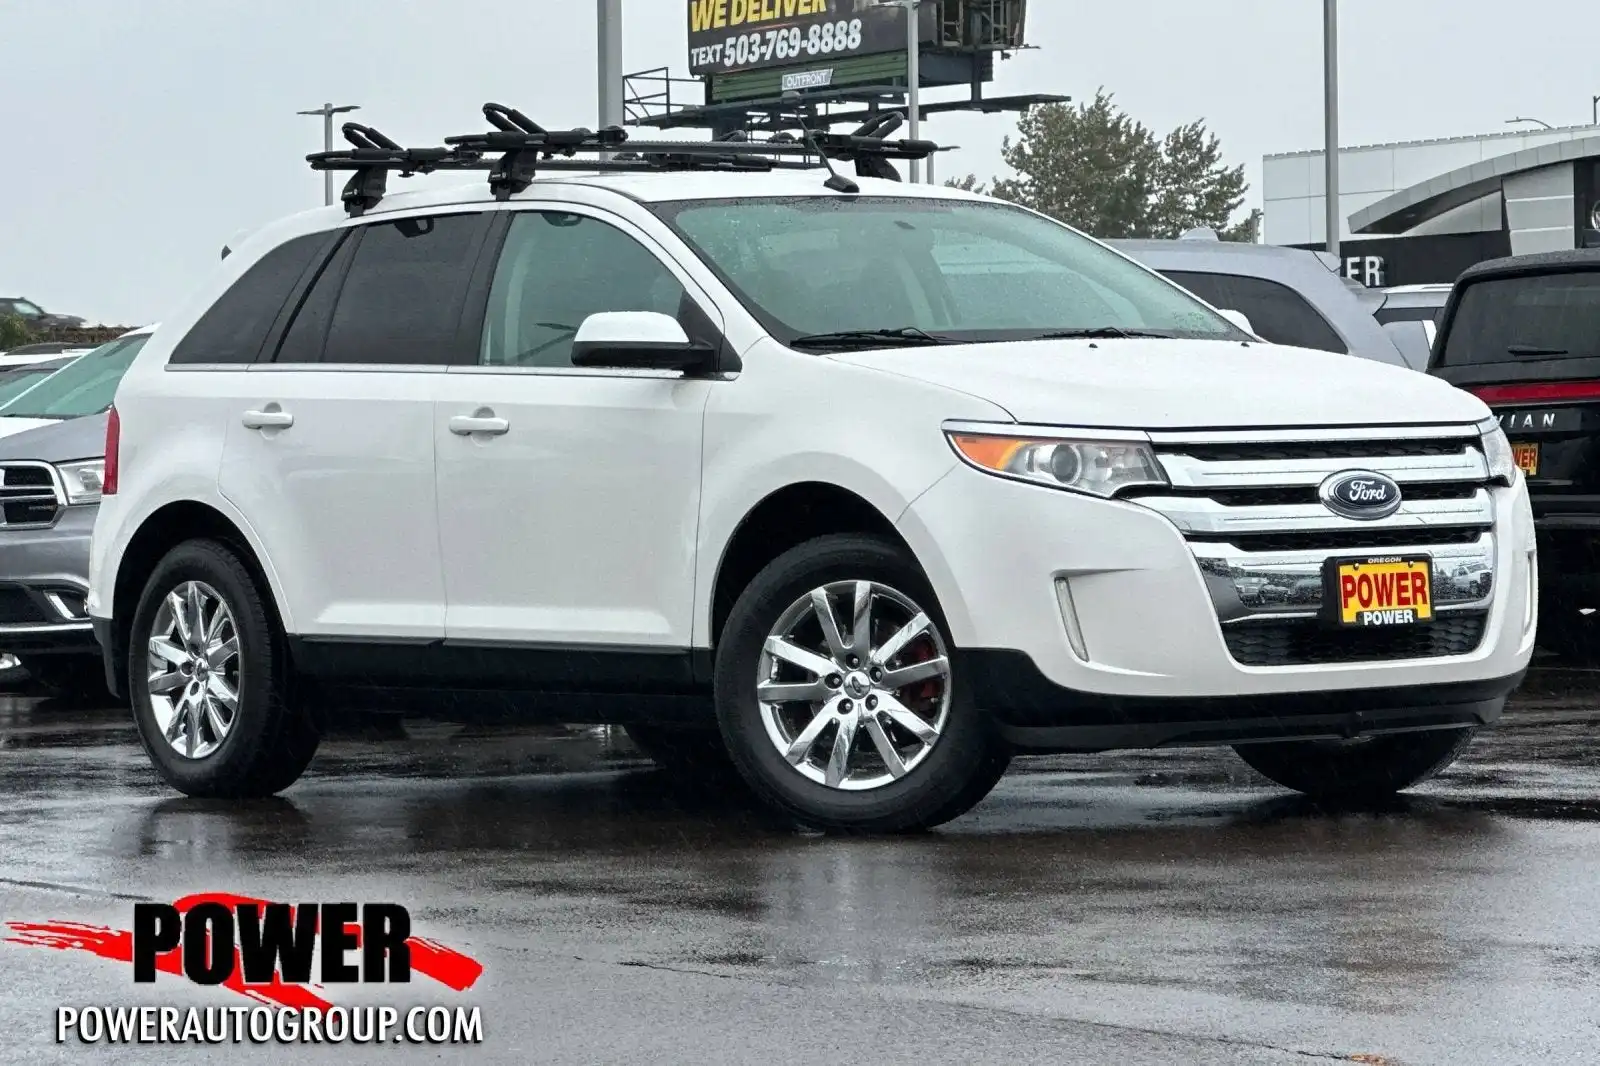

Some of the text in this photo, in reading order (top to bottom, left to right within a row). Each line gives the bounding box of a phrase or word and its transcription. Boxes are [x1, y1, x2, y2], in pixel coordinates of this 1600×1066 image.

[691, 0, 727, 32] WE
[691, 18, 862, 67] TEXT 503-769-8888
[786, 71, 826, 87] OUTFRONT
[1349, 480, 1387, 501] Ford
[1367, 556, 1402, 564] OREGON
[1341, 571, 1428, 609] POWER
[1363, 609, 1414, 626] POWER
